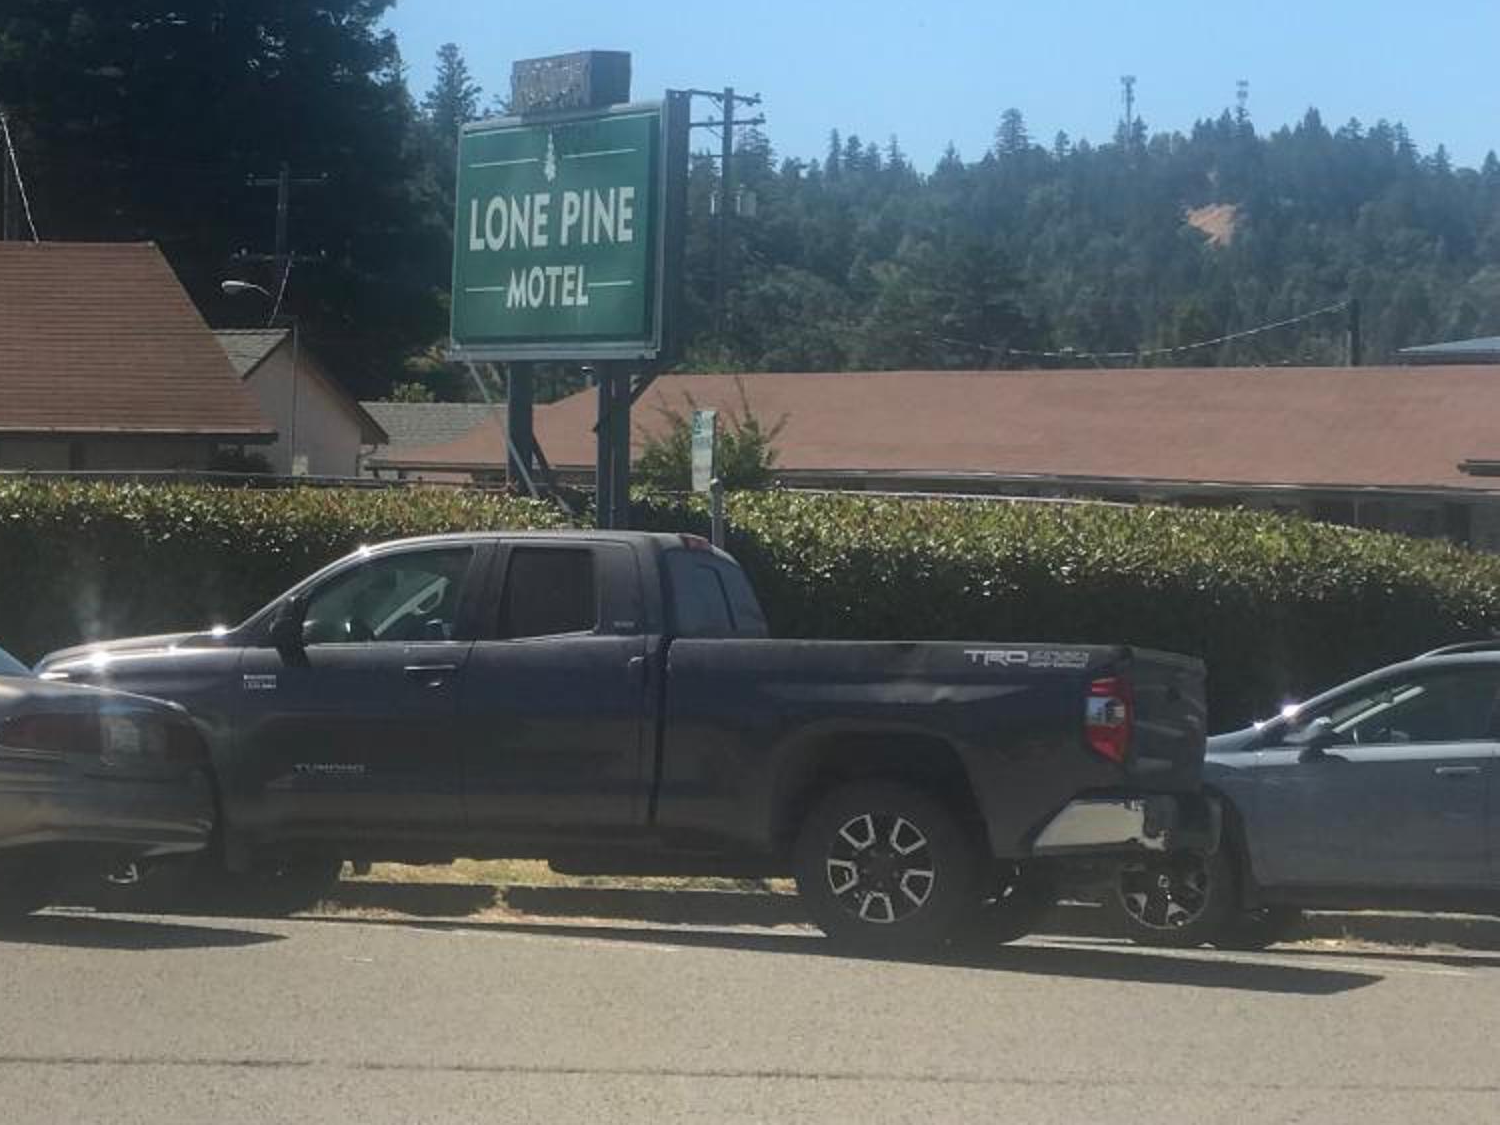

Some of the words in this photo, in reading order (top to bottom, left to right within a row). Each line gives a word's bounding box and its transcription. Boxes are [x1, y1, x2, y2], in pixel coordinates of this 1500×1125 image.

[469, 192, 550, 251] LONE
[560, 186, 635, 246] PINE
[506, 265, 589, 308] MOTEL
